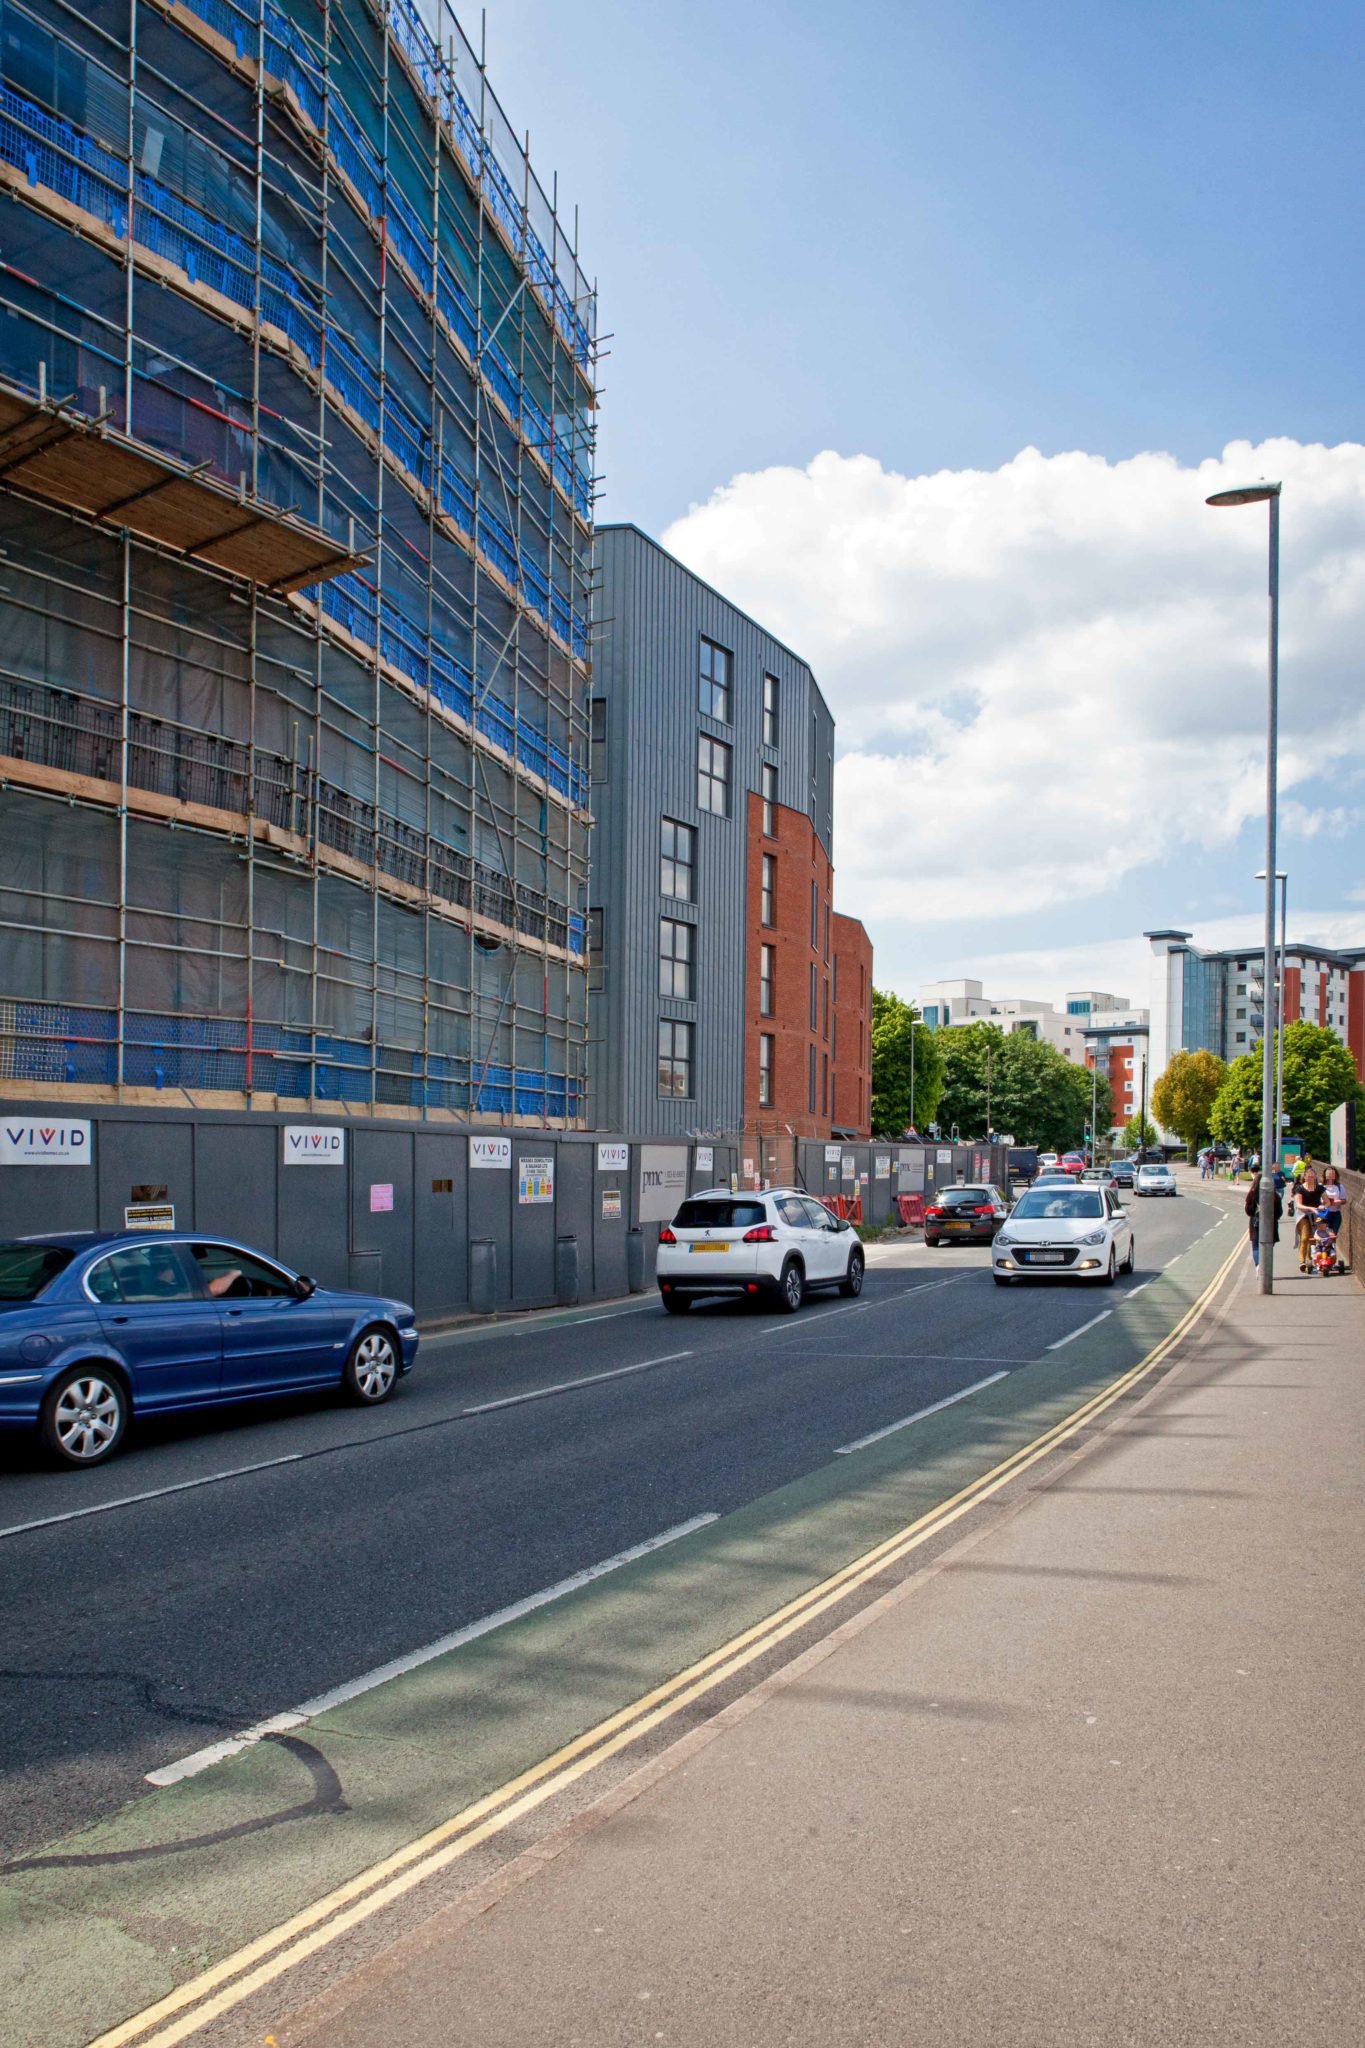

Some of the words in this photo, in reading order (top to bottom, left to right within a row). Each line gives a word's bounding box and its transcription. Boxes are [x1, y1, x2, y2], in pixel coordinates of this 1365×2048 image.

[6, 1127, 85, 1146] VIVID
[290, 1134, 341, 1149] VIVID
[473, 1143, 509, 1156] VIVID
[600, 1148, 627, 1160] VIVID
[641, 1170, 663, 1194] pmc
